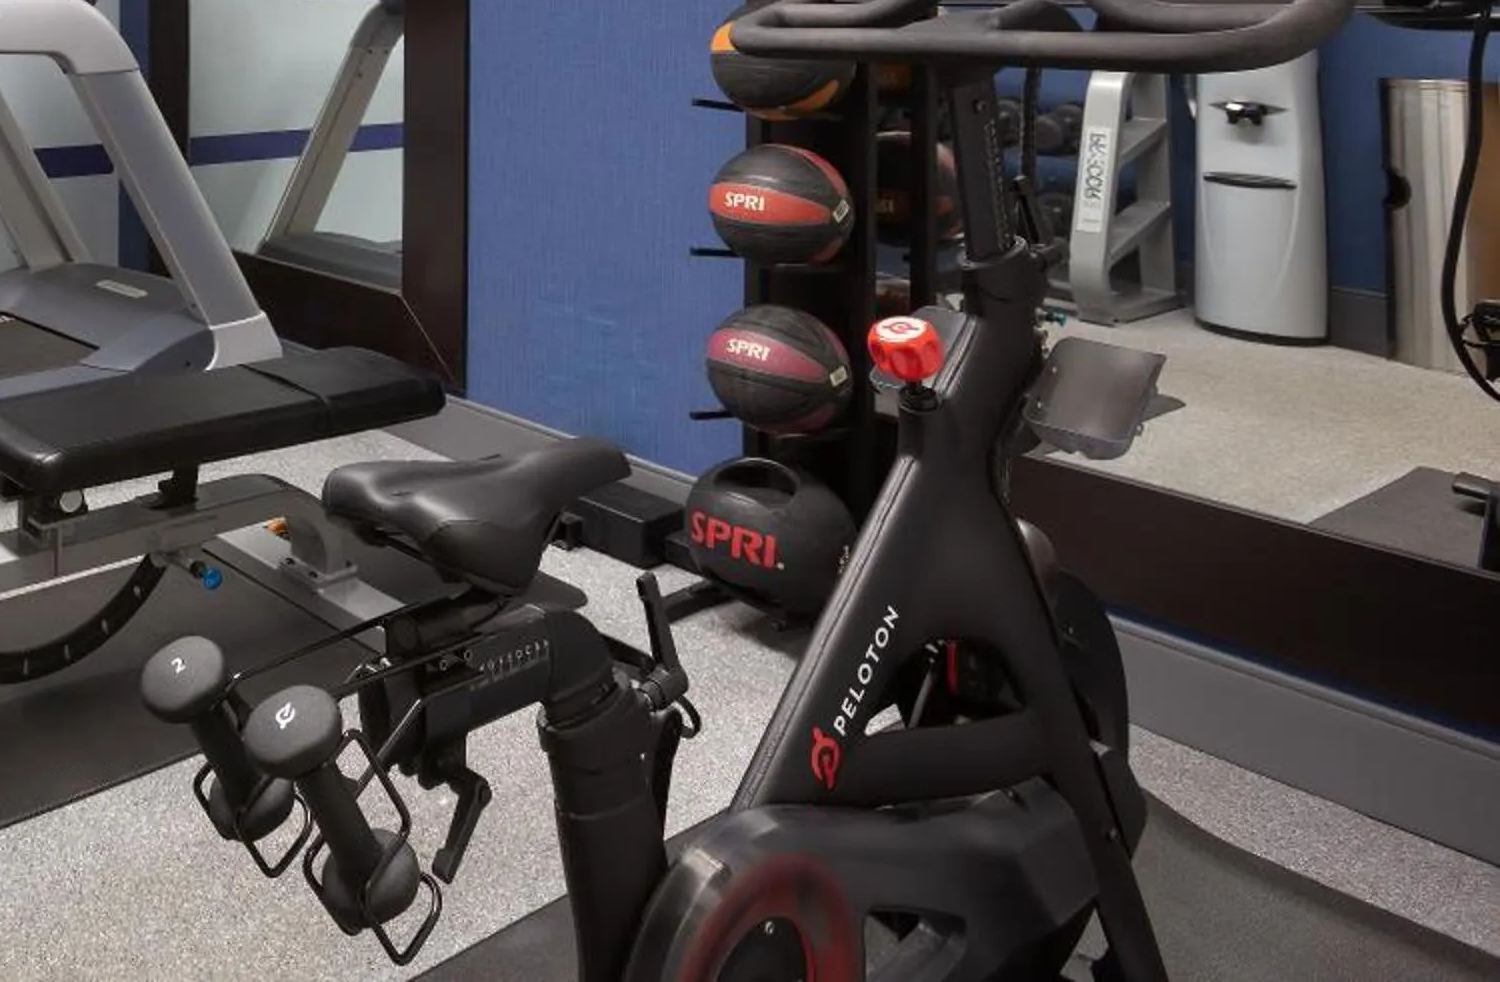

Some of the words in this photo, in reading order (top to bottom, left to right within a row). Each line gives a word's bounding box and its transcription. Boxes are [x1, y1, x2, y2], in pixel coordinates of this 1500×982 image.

[724, 192, 766, 212] SPRI
[727, 338, 771, 361] SPRI
[171, 657, 186, 674] 2
[833, 604, 901, 738] PELOTON
